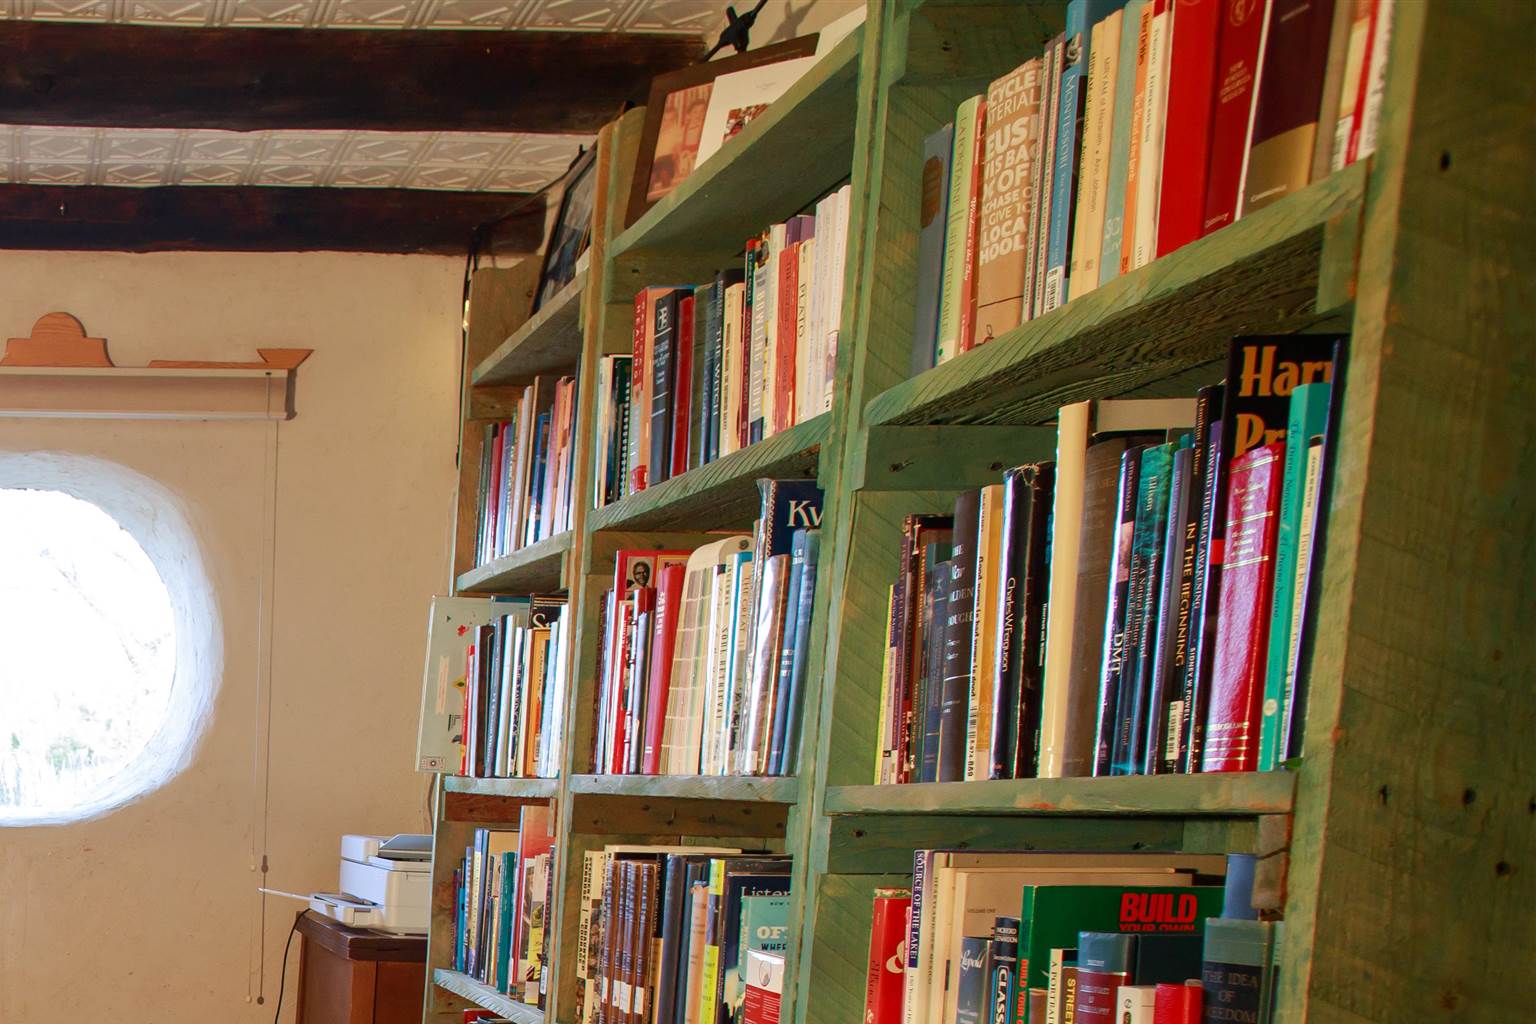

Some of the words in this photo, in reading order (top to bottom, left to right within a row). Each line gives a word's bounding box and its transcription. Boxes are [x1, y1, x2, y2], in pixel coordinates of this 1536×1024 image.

[1059, 74, 1075, 168] MONTESSORI
[753, 289, 765, 362] BOWLING
[795, 281, 808, 339] PLATO
[714, 326, 723, 359] THE
[712, 362, 720, 416] WITCH
[750, 368, 761, 414] ALONE
[1193, 398, 1207, 441] Hamilton
[1205, 442, 1217, 487] TOWARD
[1145, 475, 1157, 511] Ellison
[1203, 490, 1212, 510] THE
[1185, 521, 1196, 539] IN
[1199, 511, 1210, 545] GREAT
[1148, 552, 1158, 570] On
[1182, 543, 1195, 577] THE
[741, 575, 750, 597] THE
[1004, 576, 1015, 614] Charles
[1135, 576, 1146, 607] Natural
[1192, 547, 1206, 609] AWAKENING
[738, 597, 748, 633] GREAT
[1131, 613, 1142, 646] History
[1174, 582, 1192, 666] BEGINNING
[719, 626, 728, 654] SOUL
[999, 626, 1012, 673] Ferguson
[1109, 631, 1123, 676] DMT
[1187, 647, 1196, 677] SIDNEY
[715, 658, 727, 720] RETRIEVAL
[1183, 689, 1192, 722] POWELL
[913, 852, 925, 893] SOURCE
[913, 893, 922, 907] OF
[1120, 893, 1197, 924] BUILD
[911, 908, 920, 928] THE
[1018, 958, 1028, 988] BUILD
[1228, 973, 1259, 987] IDEA
[1016, 989, 1026, 1017] YOUR
[1218, 990, 1235, 1001] OF
